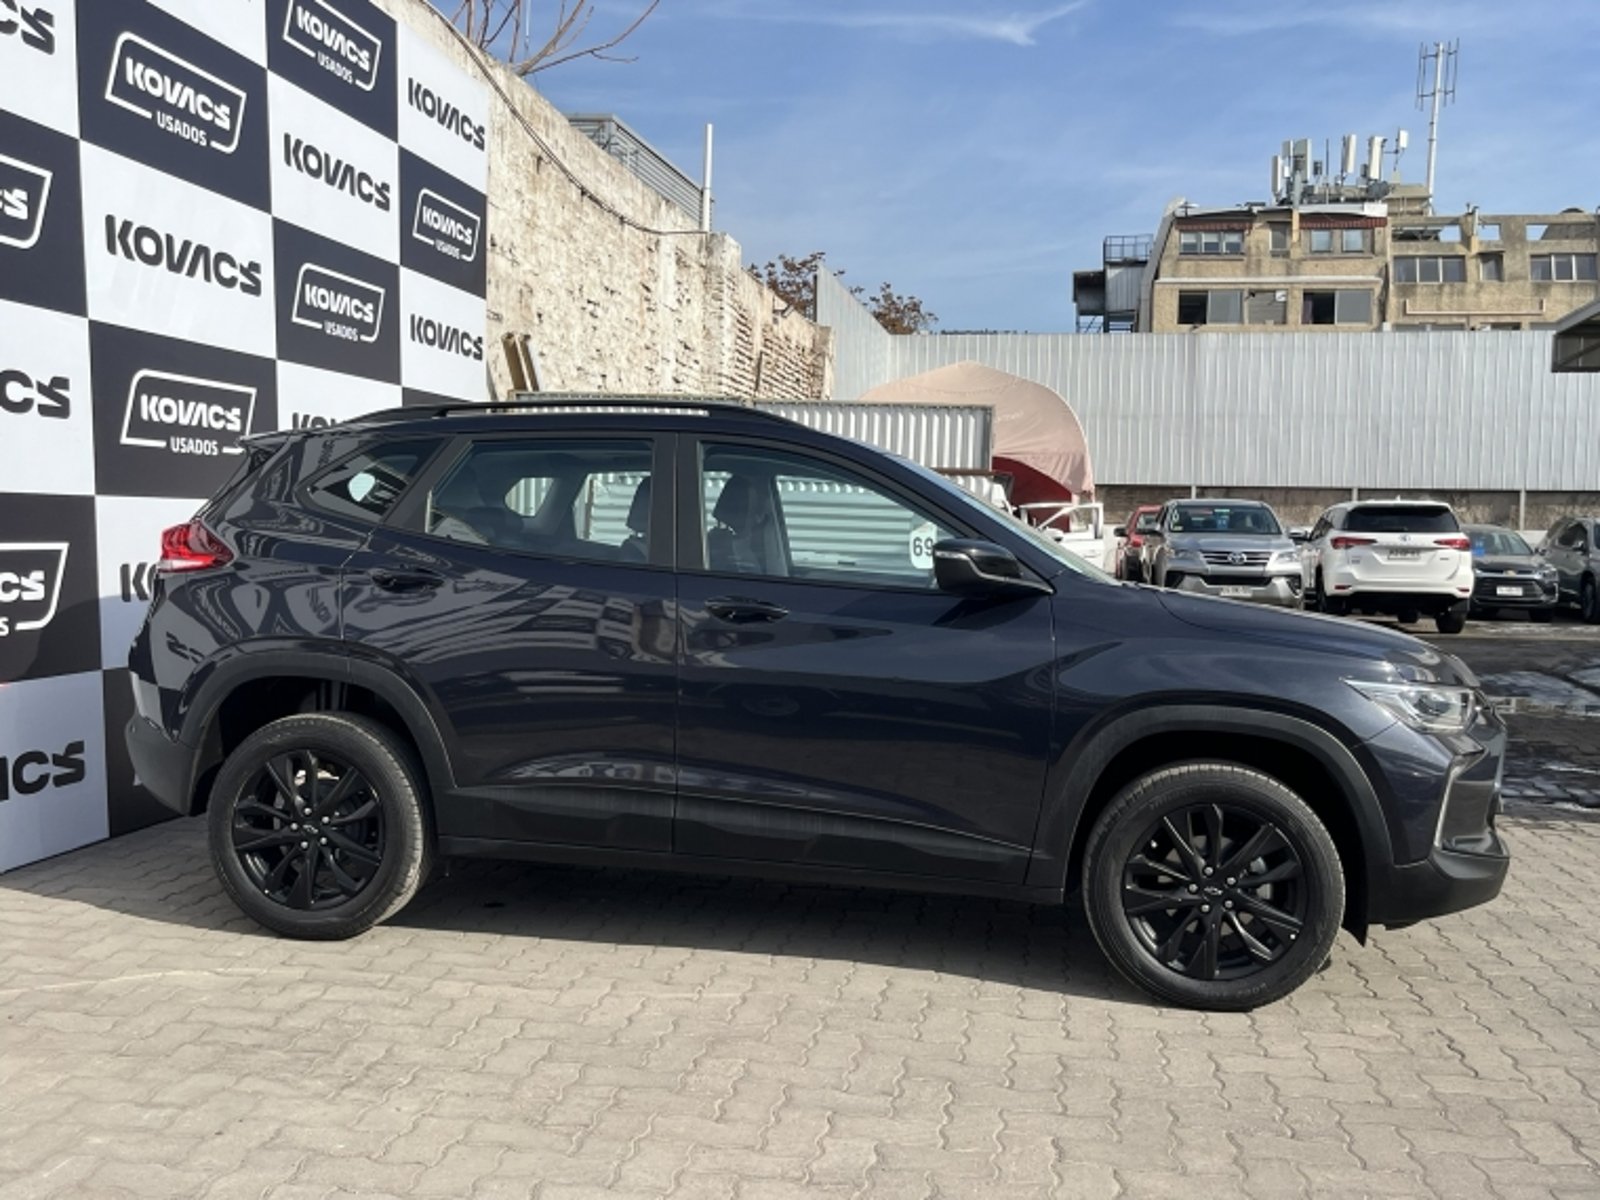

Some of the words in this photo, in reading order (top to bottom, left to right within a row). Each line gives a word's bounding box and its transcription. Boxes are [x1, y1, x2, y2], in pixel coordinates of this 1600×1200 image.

[296, 6, 370, 72] KOVACS
[126, 57, 231, 131] KOVACS
[408, 78, 486, 151] KOVACS
[157, 111, 207, 147] USADOS
[283, 132, 391, 211] KOVACS
[422, 205, 473, 246] KOVACS
[105, 214, 262, 296] KOVACS
[304, 284, 374, 323] KOVACS
[410, 313, 484, 361] KOVACS
[140, 394, 241, 432] KOVACS
[170, 436, 219, 456] USADOS
[913, 536, 934, 557] 69
